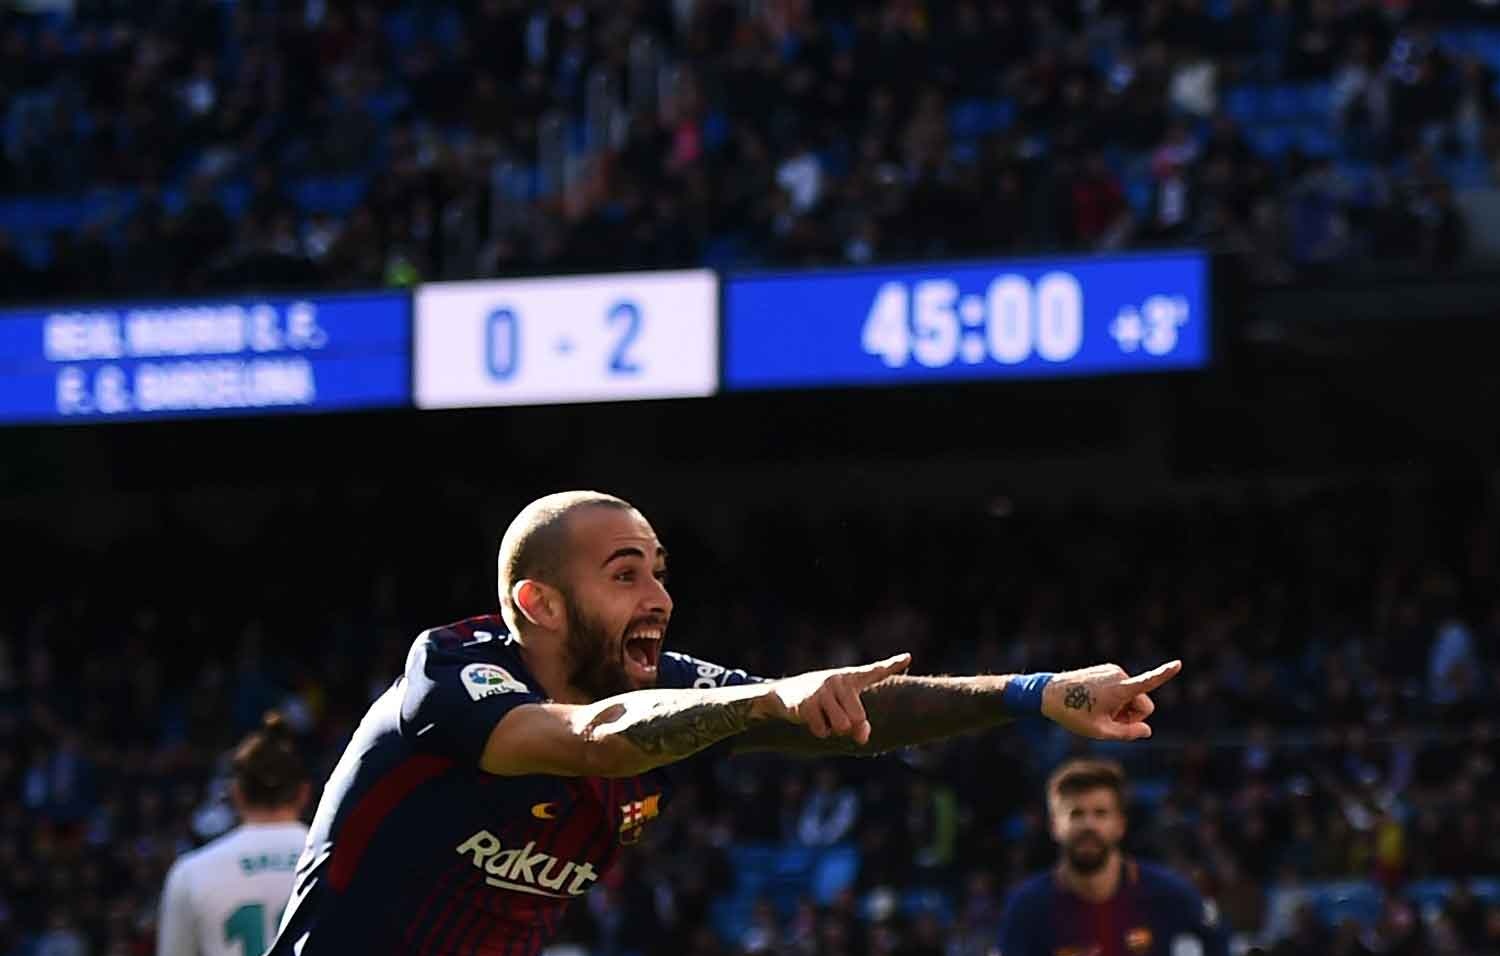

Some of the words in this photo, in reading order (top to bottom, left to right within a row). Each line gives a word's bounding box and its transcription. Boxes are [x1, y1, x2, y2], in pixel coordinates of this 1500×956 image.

[485, 307, 519, 381] 0
[606, 303, 642, 375] 2
[861, 271, 1083, 368] 45:00
